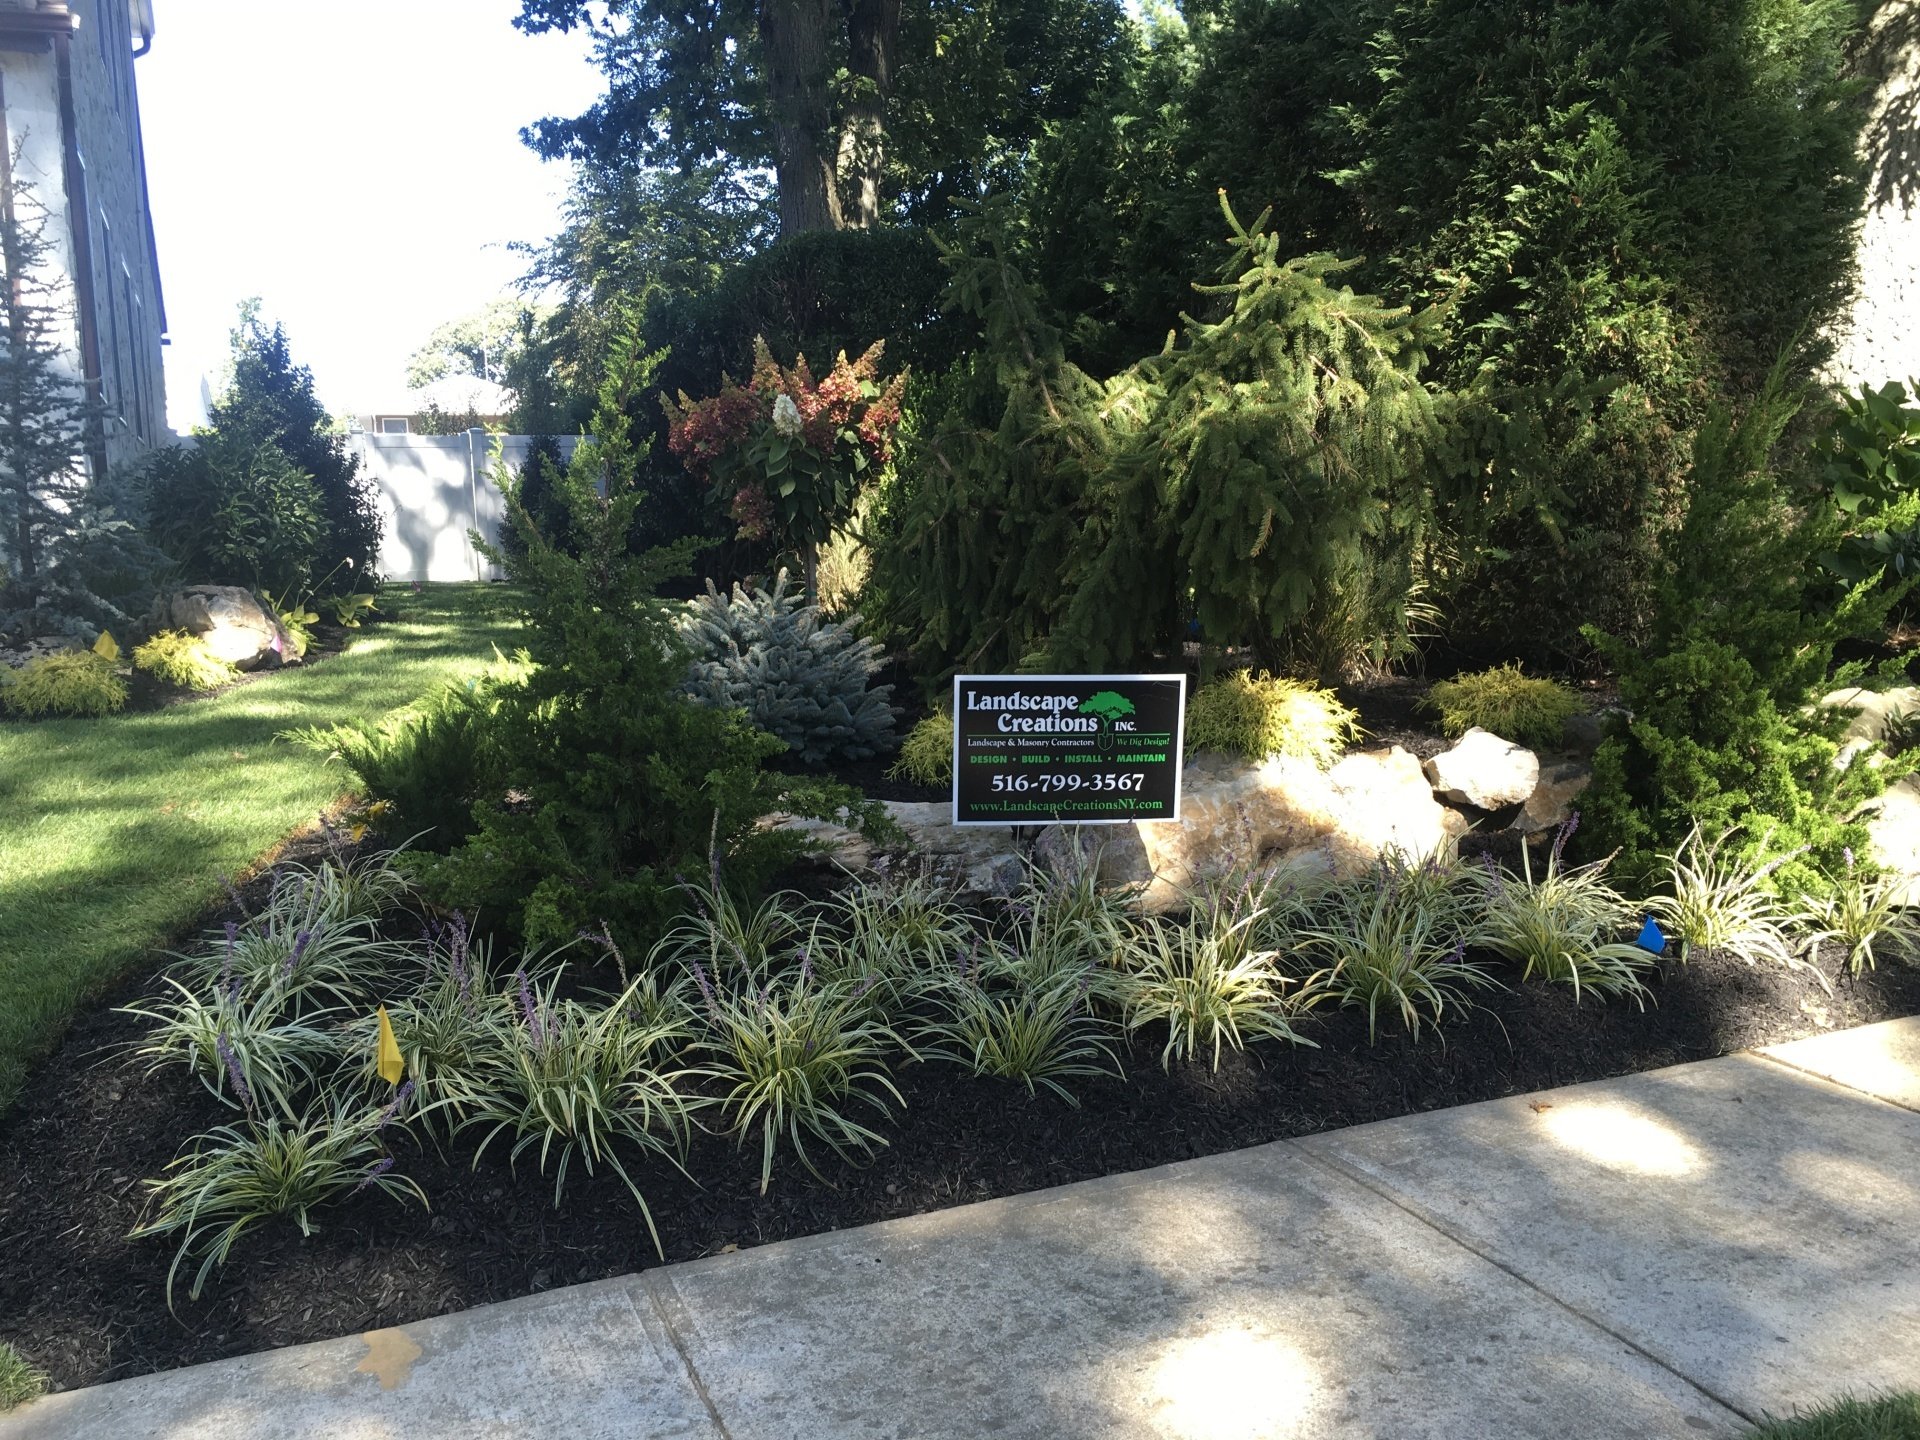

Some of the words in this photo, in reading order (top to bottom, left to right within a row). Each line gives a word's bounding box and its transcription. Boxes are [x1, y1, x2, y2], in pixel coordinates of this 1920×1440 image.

[967, 691, 1078, 715] Landscape
[997, 713, 1098, 732] Creations
[1114, 721, 1137, 731] INC.
[967, 738, 1007, 747] Landscape
[1007, 738, 1016, 746] &
[1017, 738, 1049, 748] Masonry
[1051, 737, 1095, 746] Contractors
[1129, 737, 1142, 747] Dig
[1143, 737, 1170, 747] Design!
[970, 755, 1007, 763] DESIGN
[1021, 755, 1050, 763] BUILD
[1064, 754, 1103, 763] INSTALL
[1116, 753, 1166, 762] MAINTAIN
[991, 773, 1145, 792] 516-799-3567
[970, 798, 1163, 813] www.LandscapeCreationsNY.com
